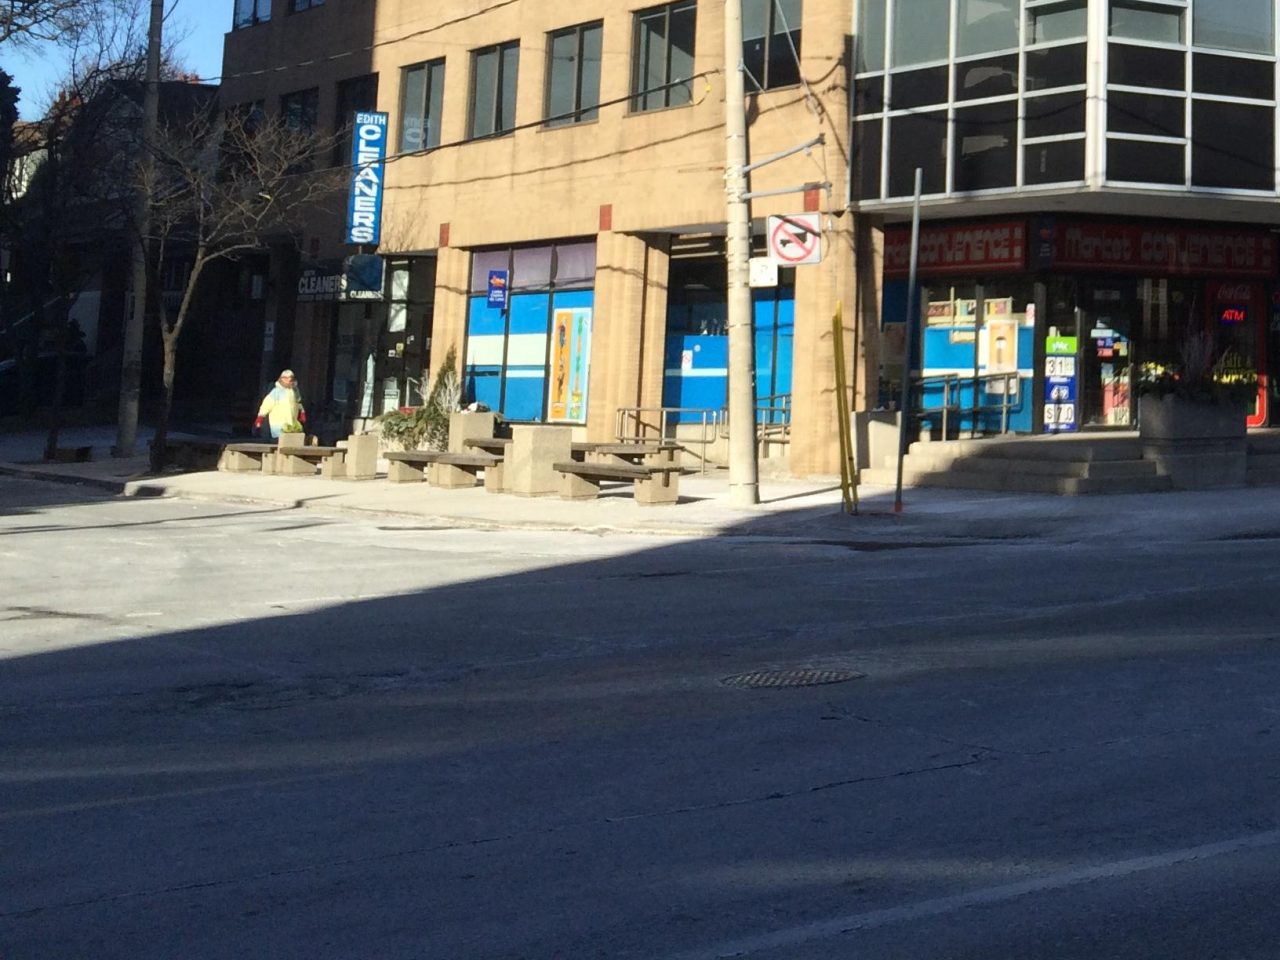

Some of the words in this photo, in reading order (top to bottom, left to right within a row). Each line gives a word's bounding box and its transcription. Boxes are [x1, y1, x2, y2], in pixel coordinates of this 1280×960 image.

[356, 113, 386, 126] EDITH
[350, 124, 382, 244] CLEANERS
[1221, 308, 1246, 321] ATM
